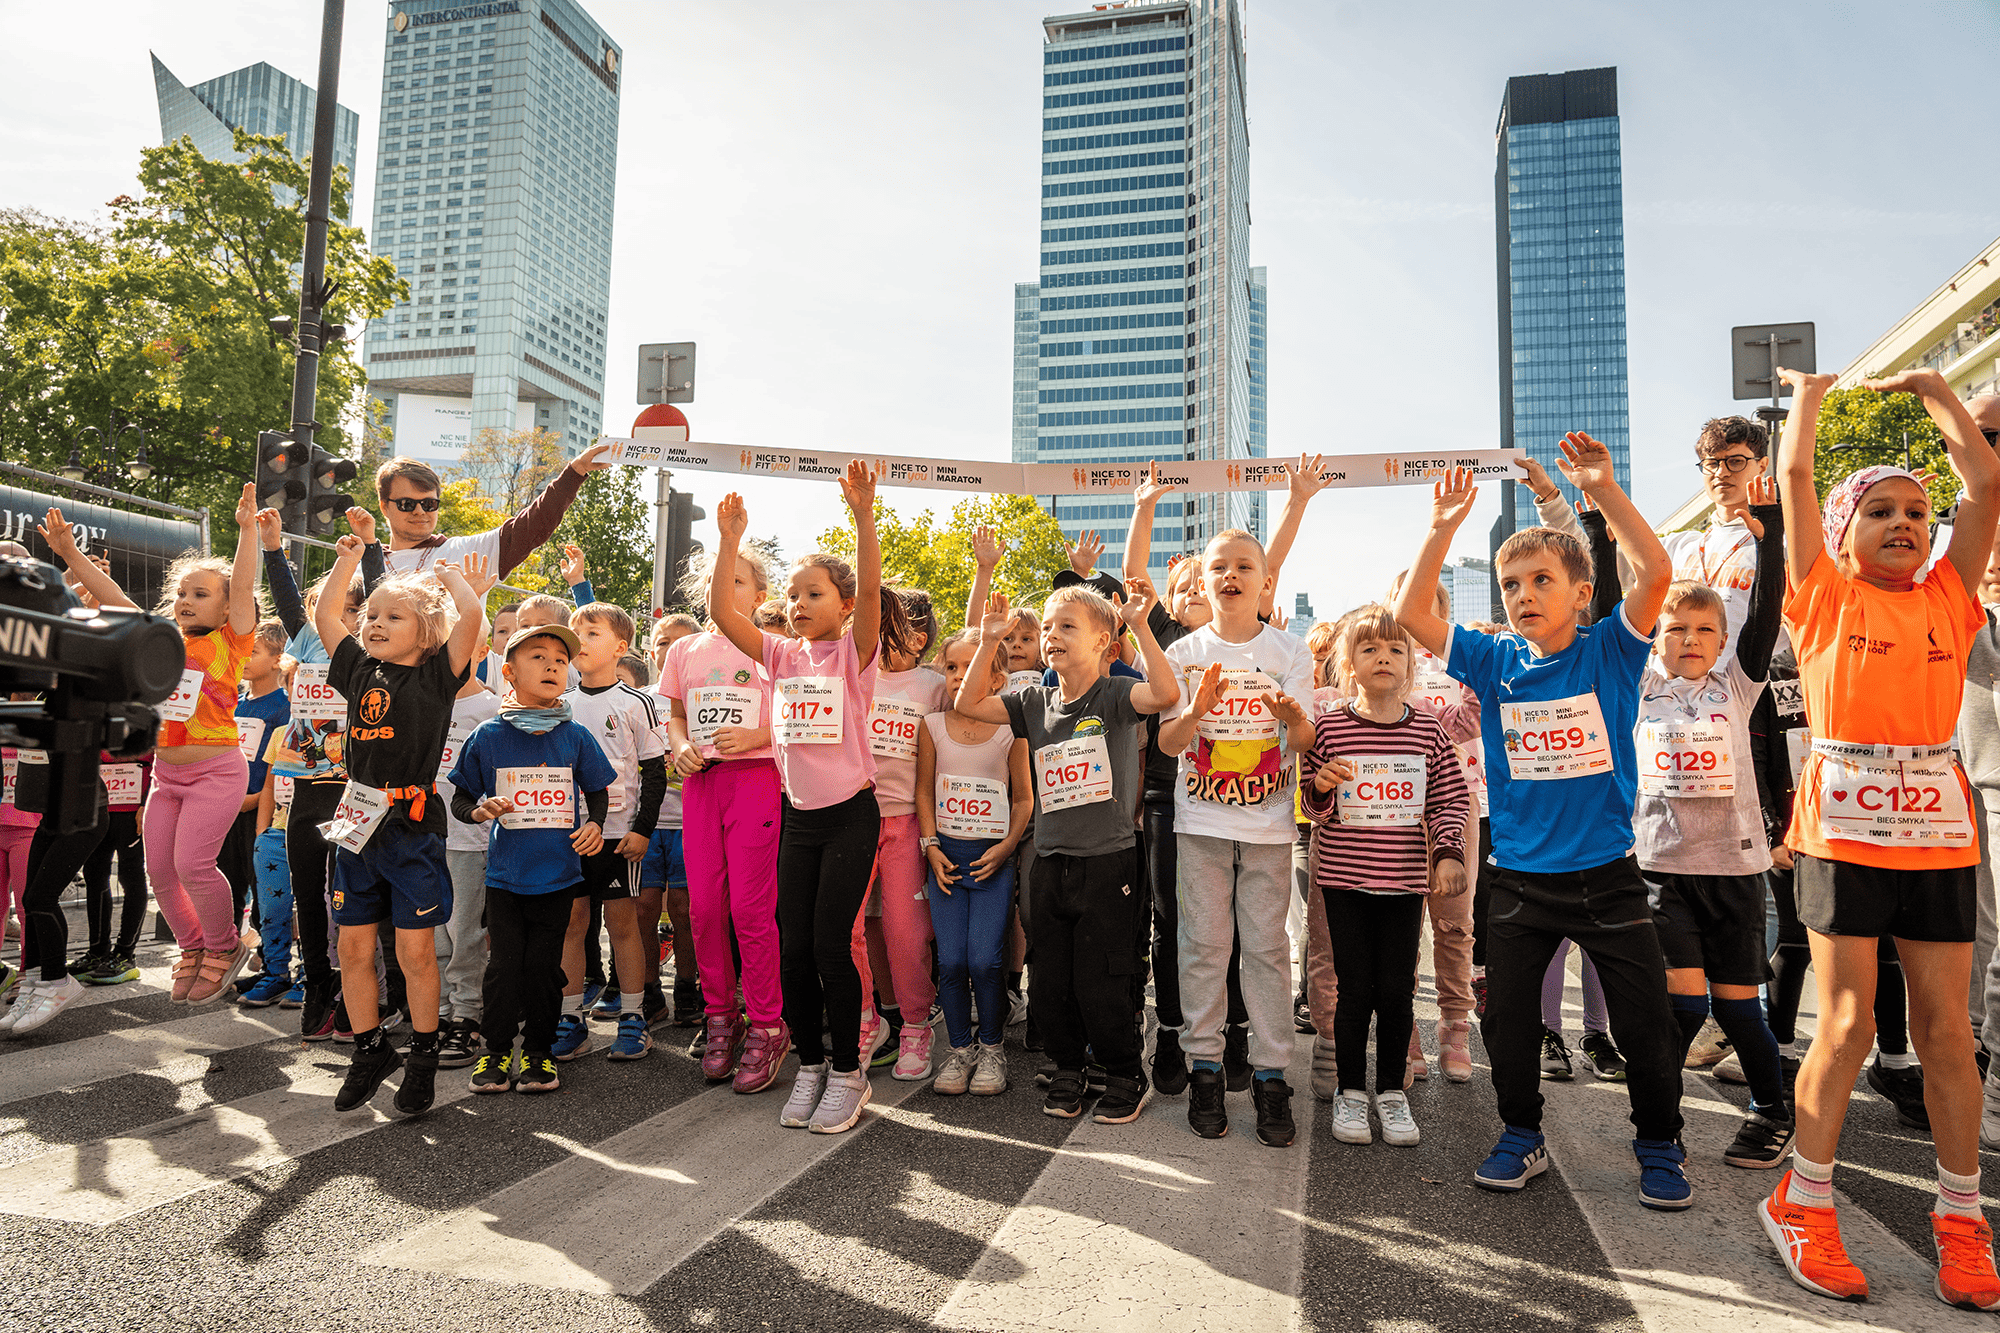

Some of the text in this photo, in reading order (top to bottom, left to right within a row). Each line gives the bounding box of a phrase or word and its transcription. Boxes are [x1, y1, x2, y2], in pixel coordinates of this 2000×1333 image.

[412, 1, 520, 26] INTERCONTINENTAL
[627, 445, 648, 453] NICE
[667, 455, 708, 465] MARATON
[756, 454, 790, 463] NICE TO
[799, 456, 817, 465] MINI
[798, 464, 841, 475] MARATON
[892, 463, 912, 471] NICE
[937, 466, 956, 474] MINI
[1246, 466, 1269, 474] NICE
[1404, 461, 1428, 469] NICE
[937, 475, 981, 484] MARATON
[1092, 470, 1130, 478] NICE TO
[297, 684, 334, 699] C165
[782, 702, 820, 719] C117
[1209, 698, 1262, 716] C176
[698, 708, 743, 724] G275
[1557, 709, 1589, 720] MARATON
[351, 726, 394, 741] KIDS
[872, 719, 915, 739] C118
[1522, 727, 1585, 752] C159
[1068, 748, 1096, 757] MARATON
[1551, 753, 1573, 761] SMYKA
[1655, 751, 1717, 771] C129
[1045, 762, 1089, 787] C167
[1185, 765, 1292, 806] PIKACHU
[1357, 781, 1413, 801] C168
[354, 796, 379, 807] MARATON
[514, 790, 566, 806] C169
[1856, 785, 1942, 812] C122
[946, 797, 992, 816] C162
[1877, 816, 1896, 824] BIEG
